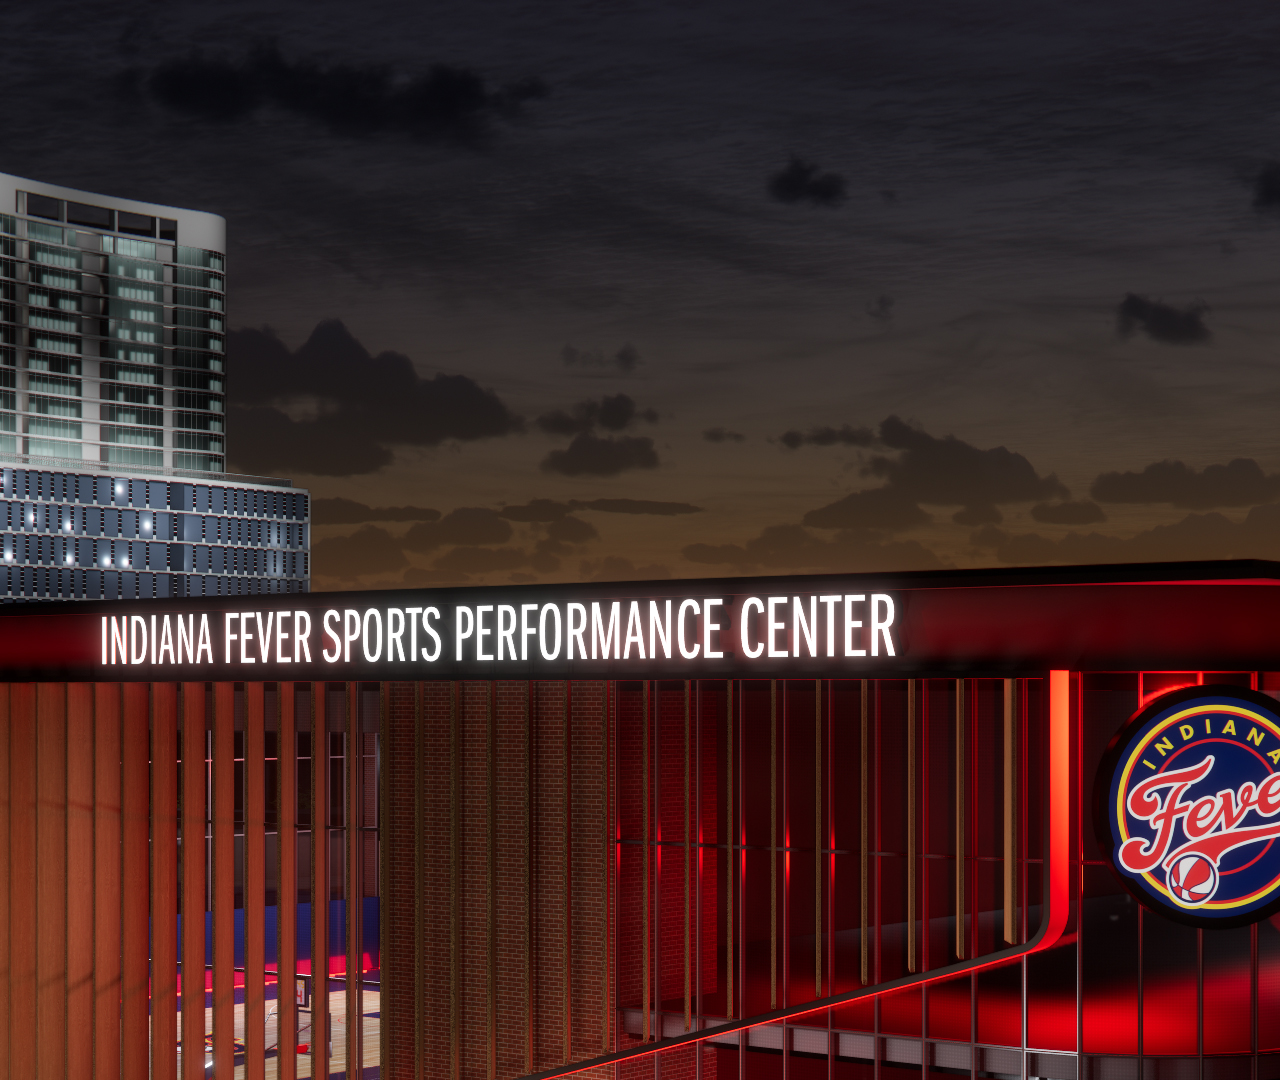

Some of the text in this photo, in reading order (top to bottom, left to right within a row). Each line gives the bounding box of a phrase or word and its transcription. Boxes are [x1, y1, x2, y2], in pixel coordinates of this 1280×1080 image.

[101, 593, 896, 665] INDIANA FEVER SPORTS PERFORMANCE CENTER
